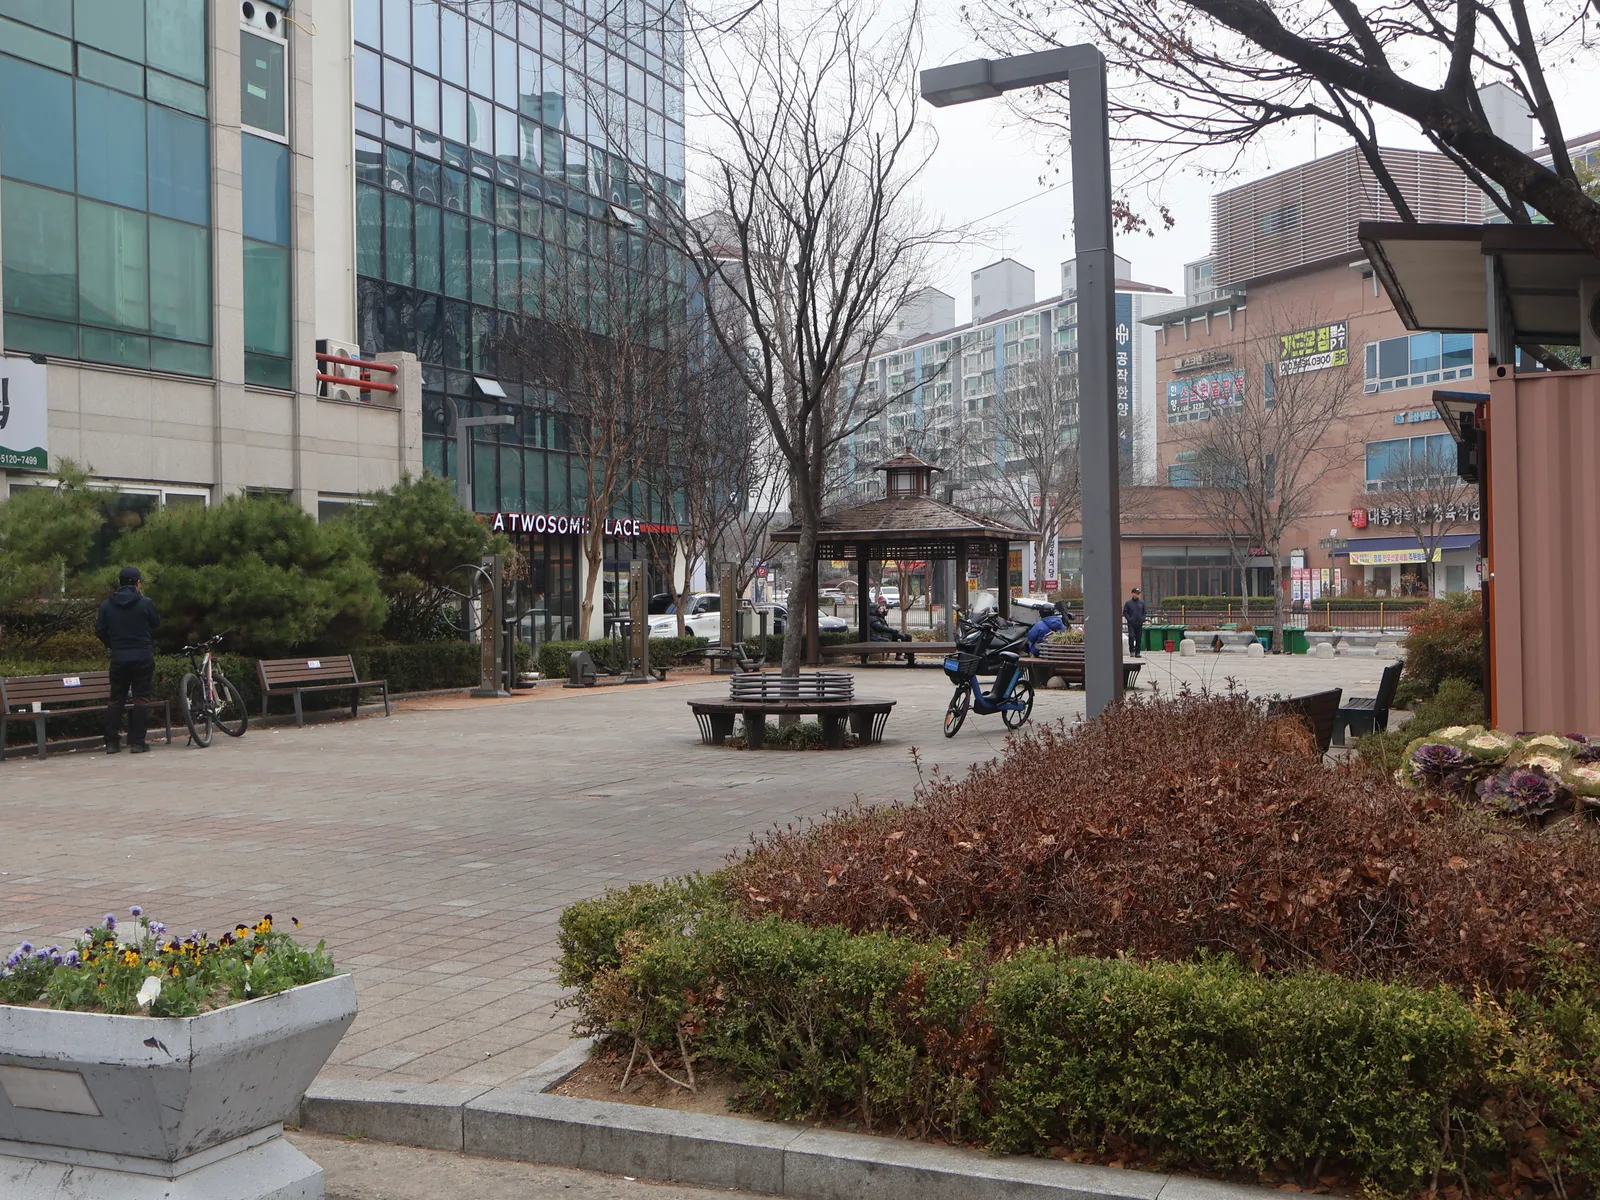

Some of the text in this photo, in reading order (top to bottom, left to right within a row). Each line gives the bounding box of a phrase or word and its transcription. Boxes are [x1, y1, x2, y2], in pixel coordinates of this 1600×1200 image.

[1330, 337, 1345, 350] PT
[1170, 385, 1177, 412] 한양
[493, 513, 504, 531] A
[601, 518, 640, 536] LACE
